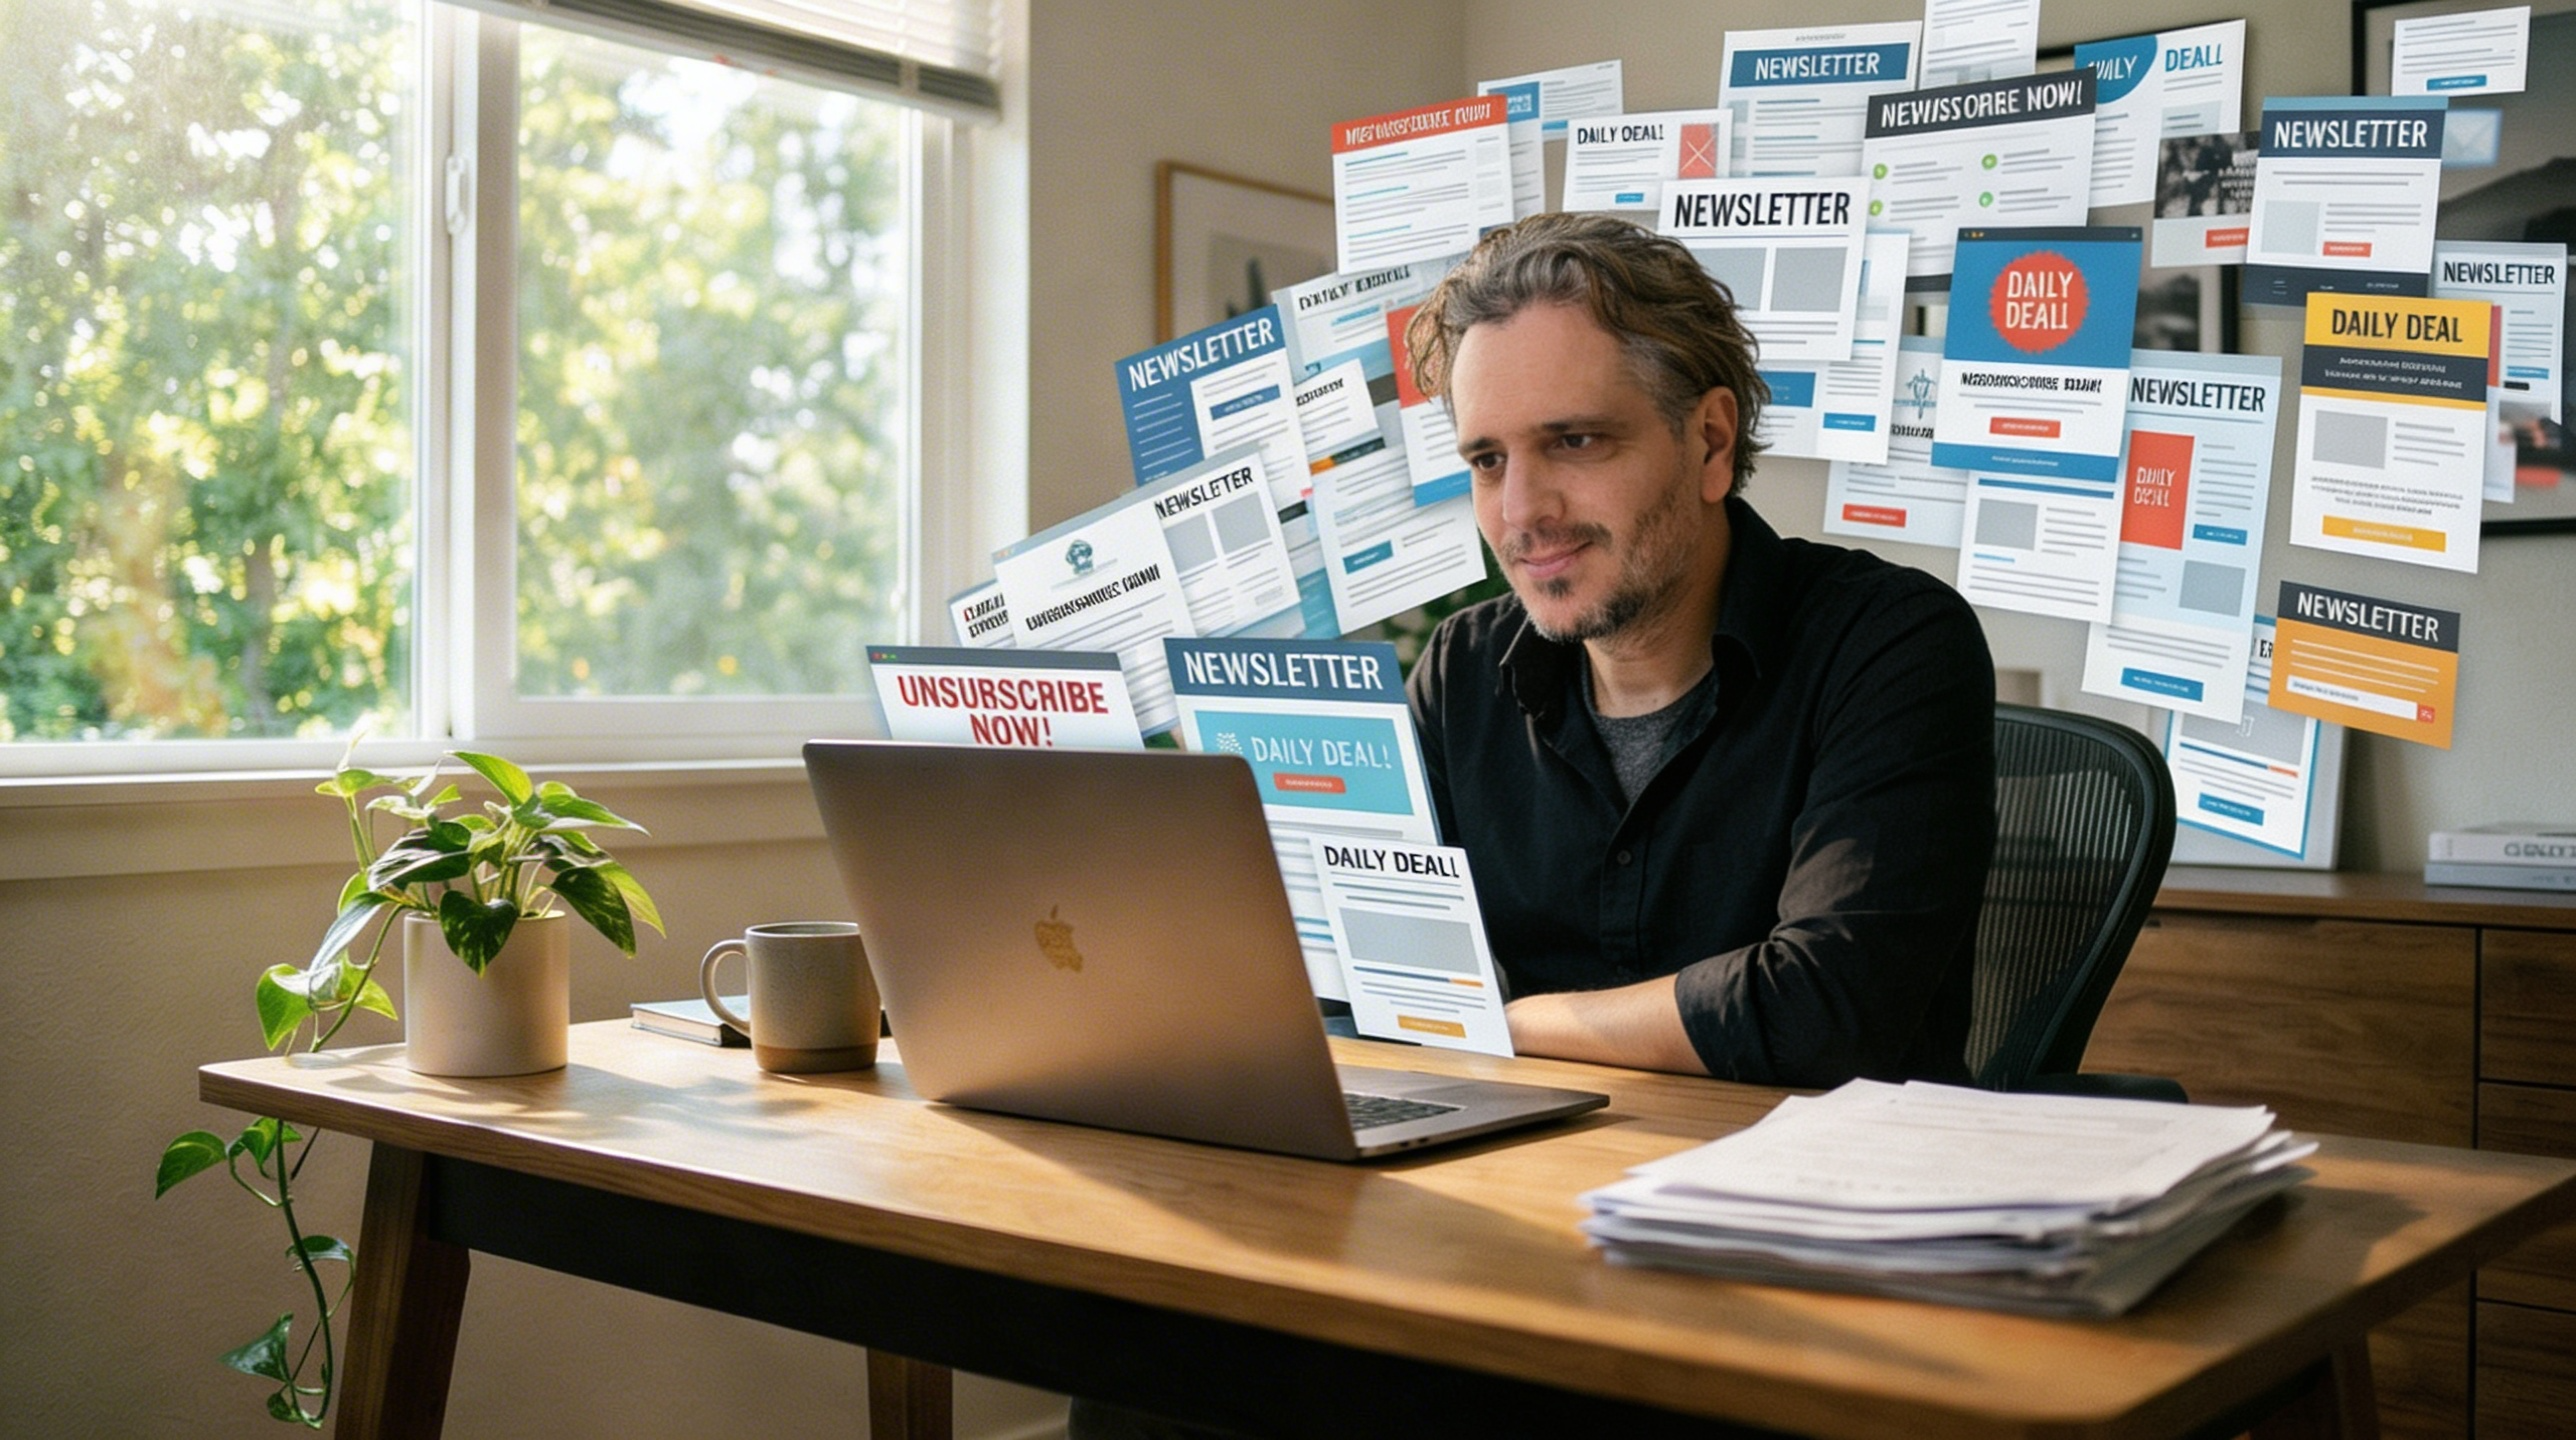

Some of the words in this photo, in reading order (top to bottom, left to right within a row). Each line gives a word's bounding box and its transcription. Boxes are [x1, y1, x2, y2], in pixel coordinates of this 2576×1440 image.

[1755, 52, 1880, 81] NEWSLETTER
[2027, 79, 2083, 112] NOW!
[1577, 126, 1618, 145] DAILY
[2274, 120, 2428, 149] NEWSLETTER
[1674, 192, 1850, 228] NEWSLETTER
[2007, 271, 2074, 298] DAILY
[2443, 261, 2555, 285] NEWSLETTER
[2331, 309, 2399, 339] DAILY
[2406, 313, 2463, 343] DEAL
[1128, 317, 1275, 392] NEWSLETTER
[2130, 377, 2266, 413] NEWSLETTER
[2297, 591, 2439, 642] NEWSLETTER
[1183, 651, 1384, 690] NEWSLETTER
[897, 675, 1109, 714] UNSUBSCRIBE
[970, 713, 1053, 747] NOW!
[1251, 736, 1314, 766] DAILY
[1322, 739, 1392, 769] DEAL!
[1323, 845, 1386, 872] DAILY
